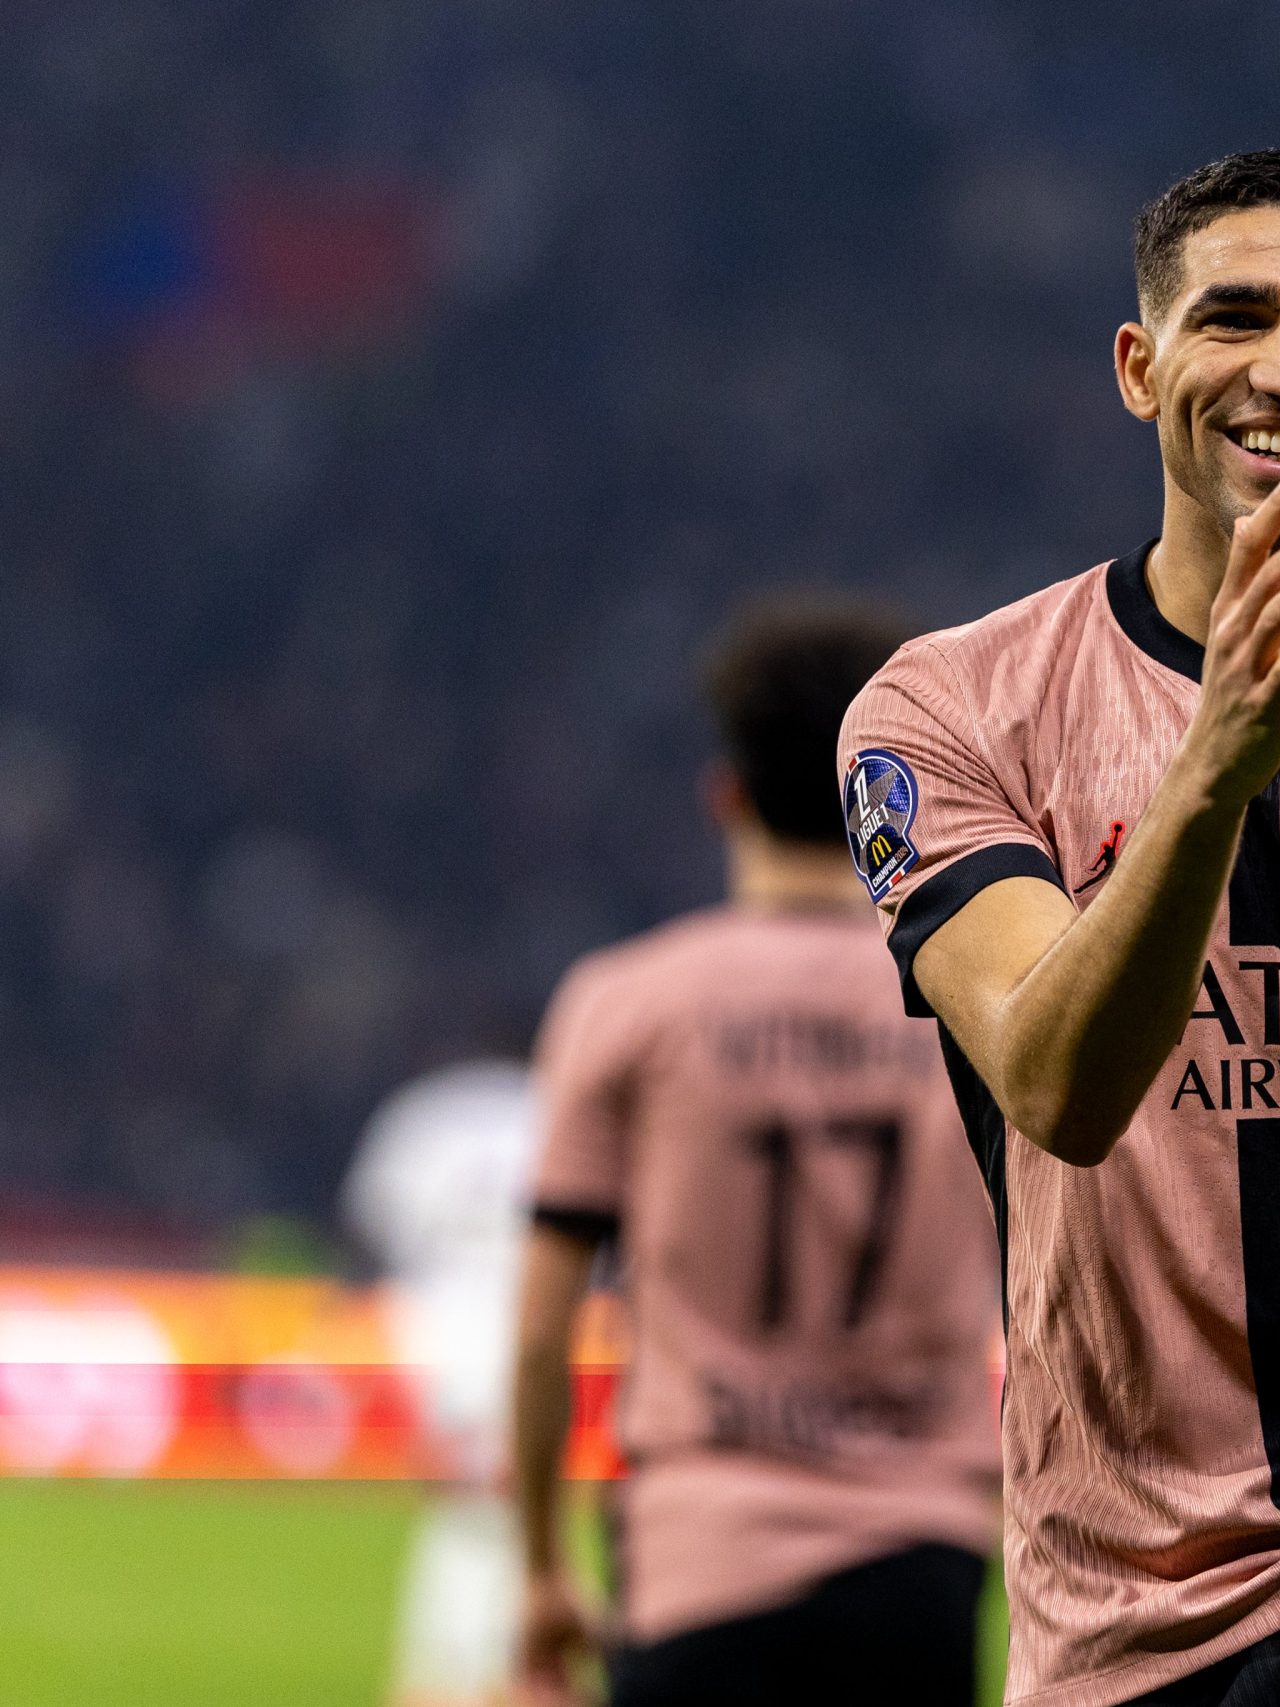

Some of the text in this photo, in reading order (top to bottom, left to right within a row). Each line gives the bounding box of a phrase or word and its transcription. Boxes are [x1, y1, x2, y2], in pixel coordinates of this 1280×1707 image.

[856, 802, 890, 850] LIGUE 1
[872, 856, 898, 888] CHAMPION
[740, 1113, 905, 1330] 17
